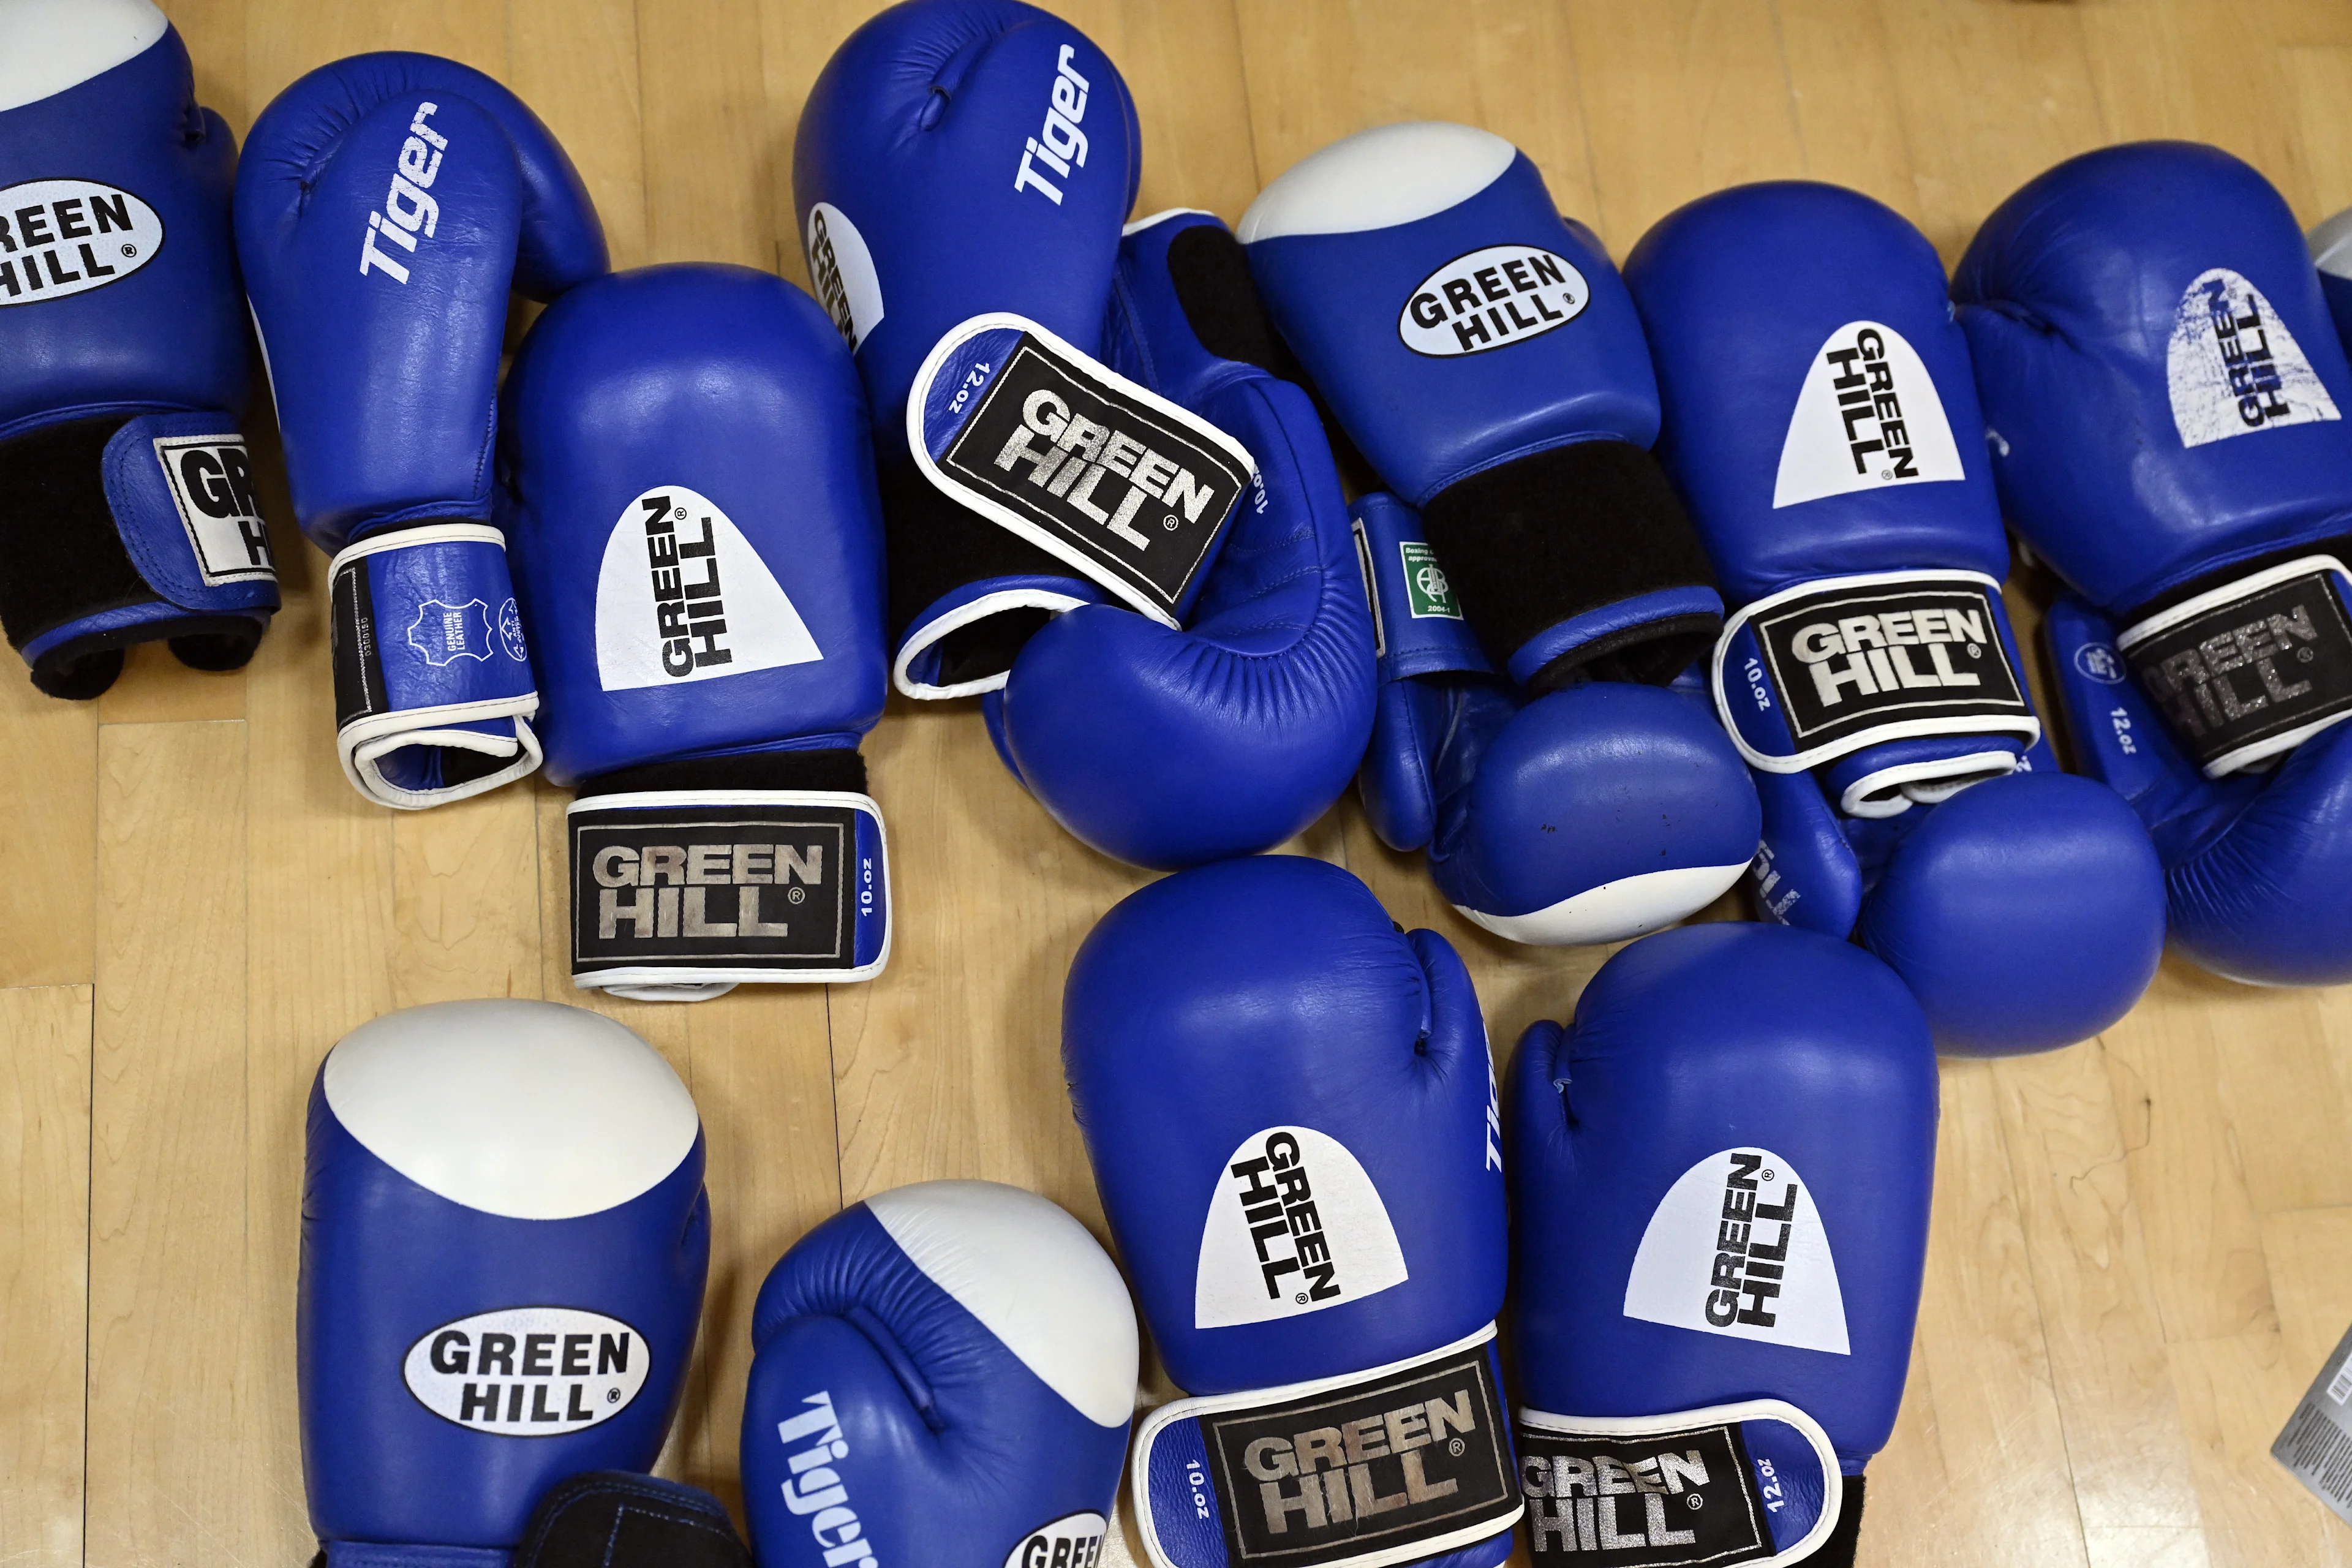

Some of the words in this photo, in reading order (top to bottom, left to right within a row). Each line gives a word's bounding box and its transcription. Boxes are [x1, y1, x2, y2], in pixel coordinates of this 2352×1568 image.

[1014, 44, 1089, 206] Tiger
[360, 102, 448, 285] Tiger
[812, 237, 843, 335] HIL
[815, 209, 857, 352] GREEN
[1410, 254, 1566, 329] GREEN
[1452, 294, 1564, 352] HILL
[2203, 279, 2265, 427] GREEN
[2236, 294, 2290, 418] HILL
[949, 363, 990, 414] 12.oz
[1826, 347, 1885, 475] HILL
[1858, 328, 1919, 478] GREEN
[993, 424, 1150, 551] HILL
[1023, 389, 1215, 524] GREEN
[642, 496, 694, 677] GREEN
[679, 517, 733, 668] HILL
[443, 612, 456, 652] GENUINE
[453, 611, 466, 650] LEATHER
[1791, 608, 1988, 663] GREEN
[1744, 657, 1771, 712] 10.oz
[1809, 643, 1981, 707] HILL
[2109, 707, 2136, 755] 12.oz
[592, 843, 823, 888] GREEN
[861, 858, 873, 916] 10.oz
[599, 886, 788, 939] HILL
[1231, 1156, 1300, 1300] HILL
[1265, 1132, 1341, 1302] GREEN
[1705, 1153, 1762, 1327] GREEN
[1737, 1183, 1798, 1327] HILL
[431, 1330, 630, 1376] GREEN
[460, 1383, 594, 1422] HILL
[1244, 1389, 1476, 1482] GREEN
[1185, 1459, 1209, 1520] 10.oz
[1259, 1449, 1458, 1534] HILL
[1520, 1450, 1710, 1498] GREEN
[1757, 1458, 1785, 1513] 12.oz
[1529, 1493, 1696, 1552] HILL
